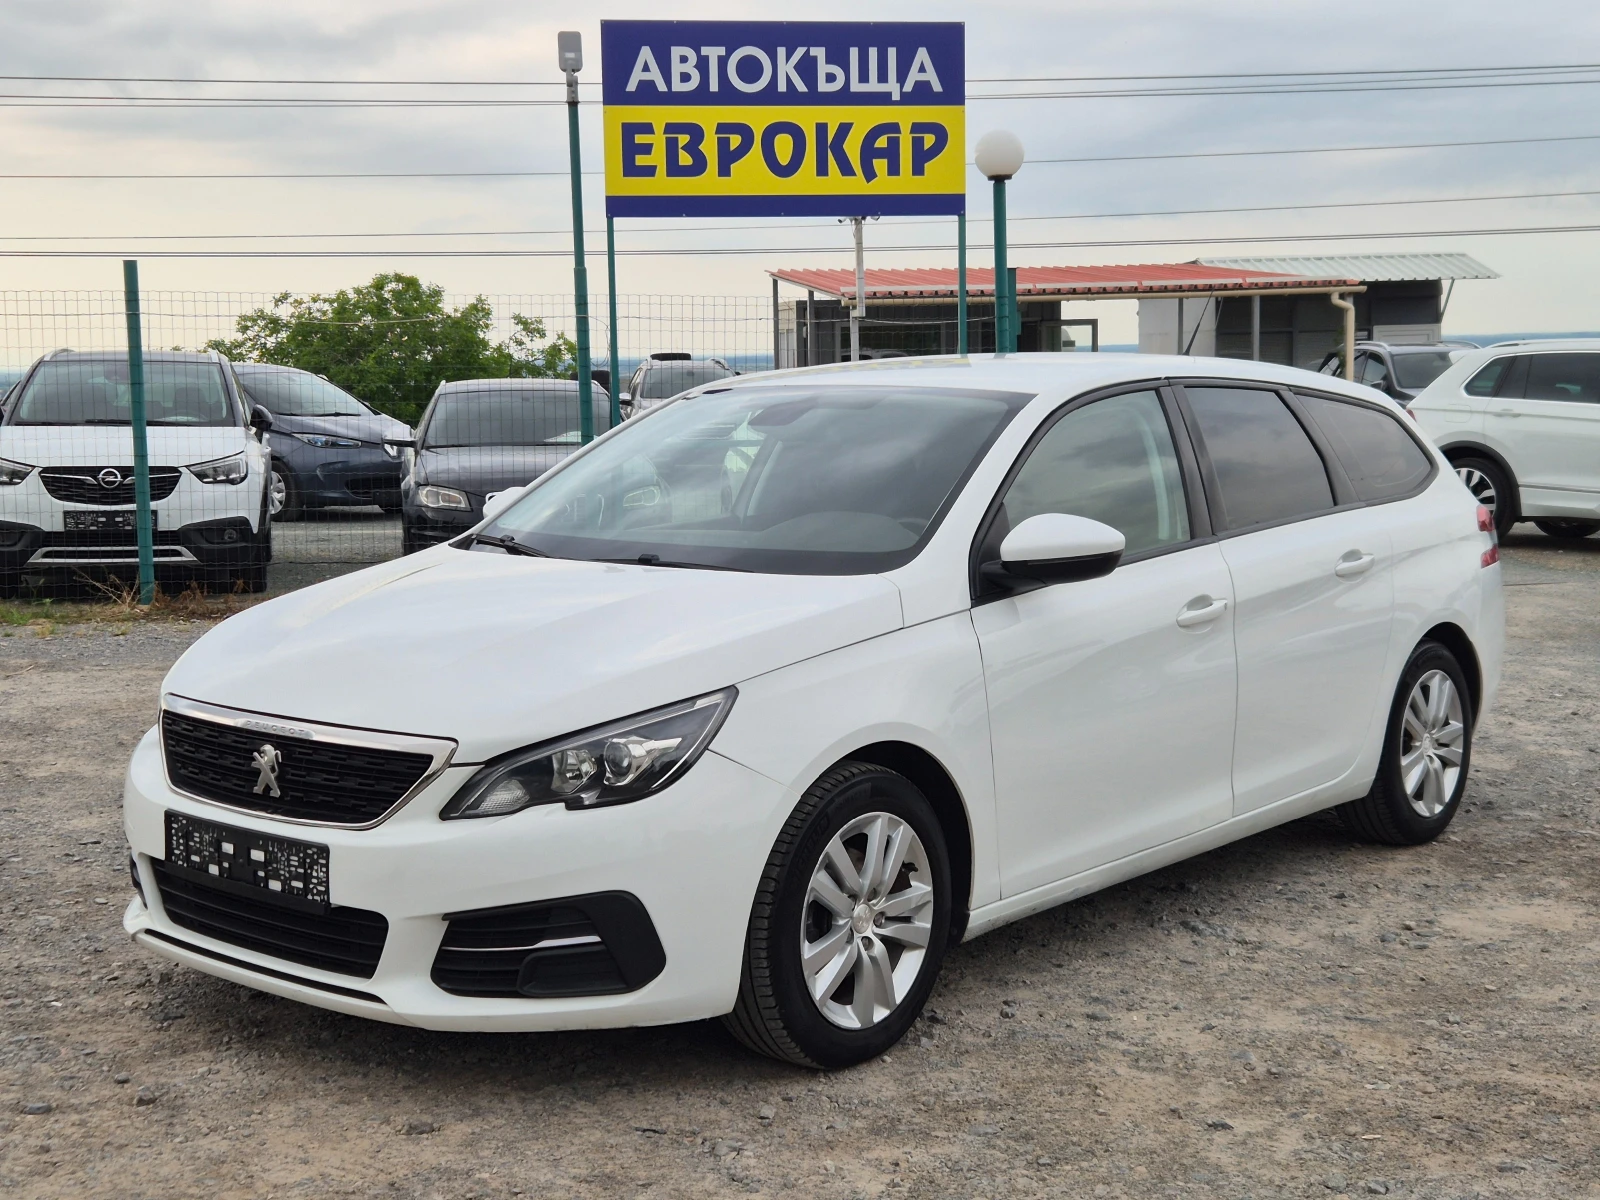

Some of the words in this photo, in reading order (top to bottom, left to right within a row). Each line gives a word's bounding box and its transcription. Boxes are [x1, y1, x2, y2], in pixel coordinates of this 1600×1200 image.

[625, 45, 944, 101] АВТОКЪЩА
[620, 120, 949, 184] ЕВРОКАР
[246, 720, 305, 735] PEUGEOT
